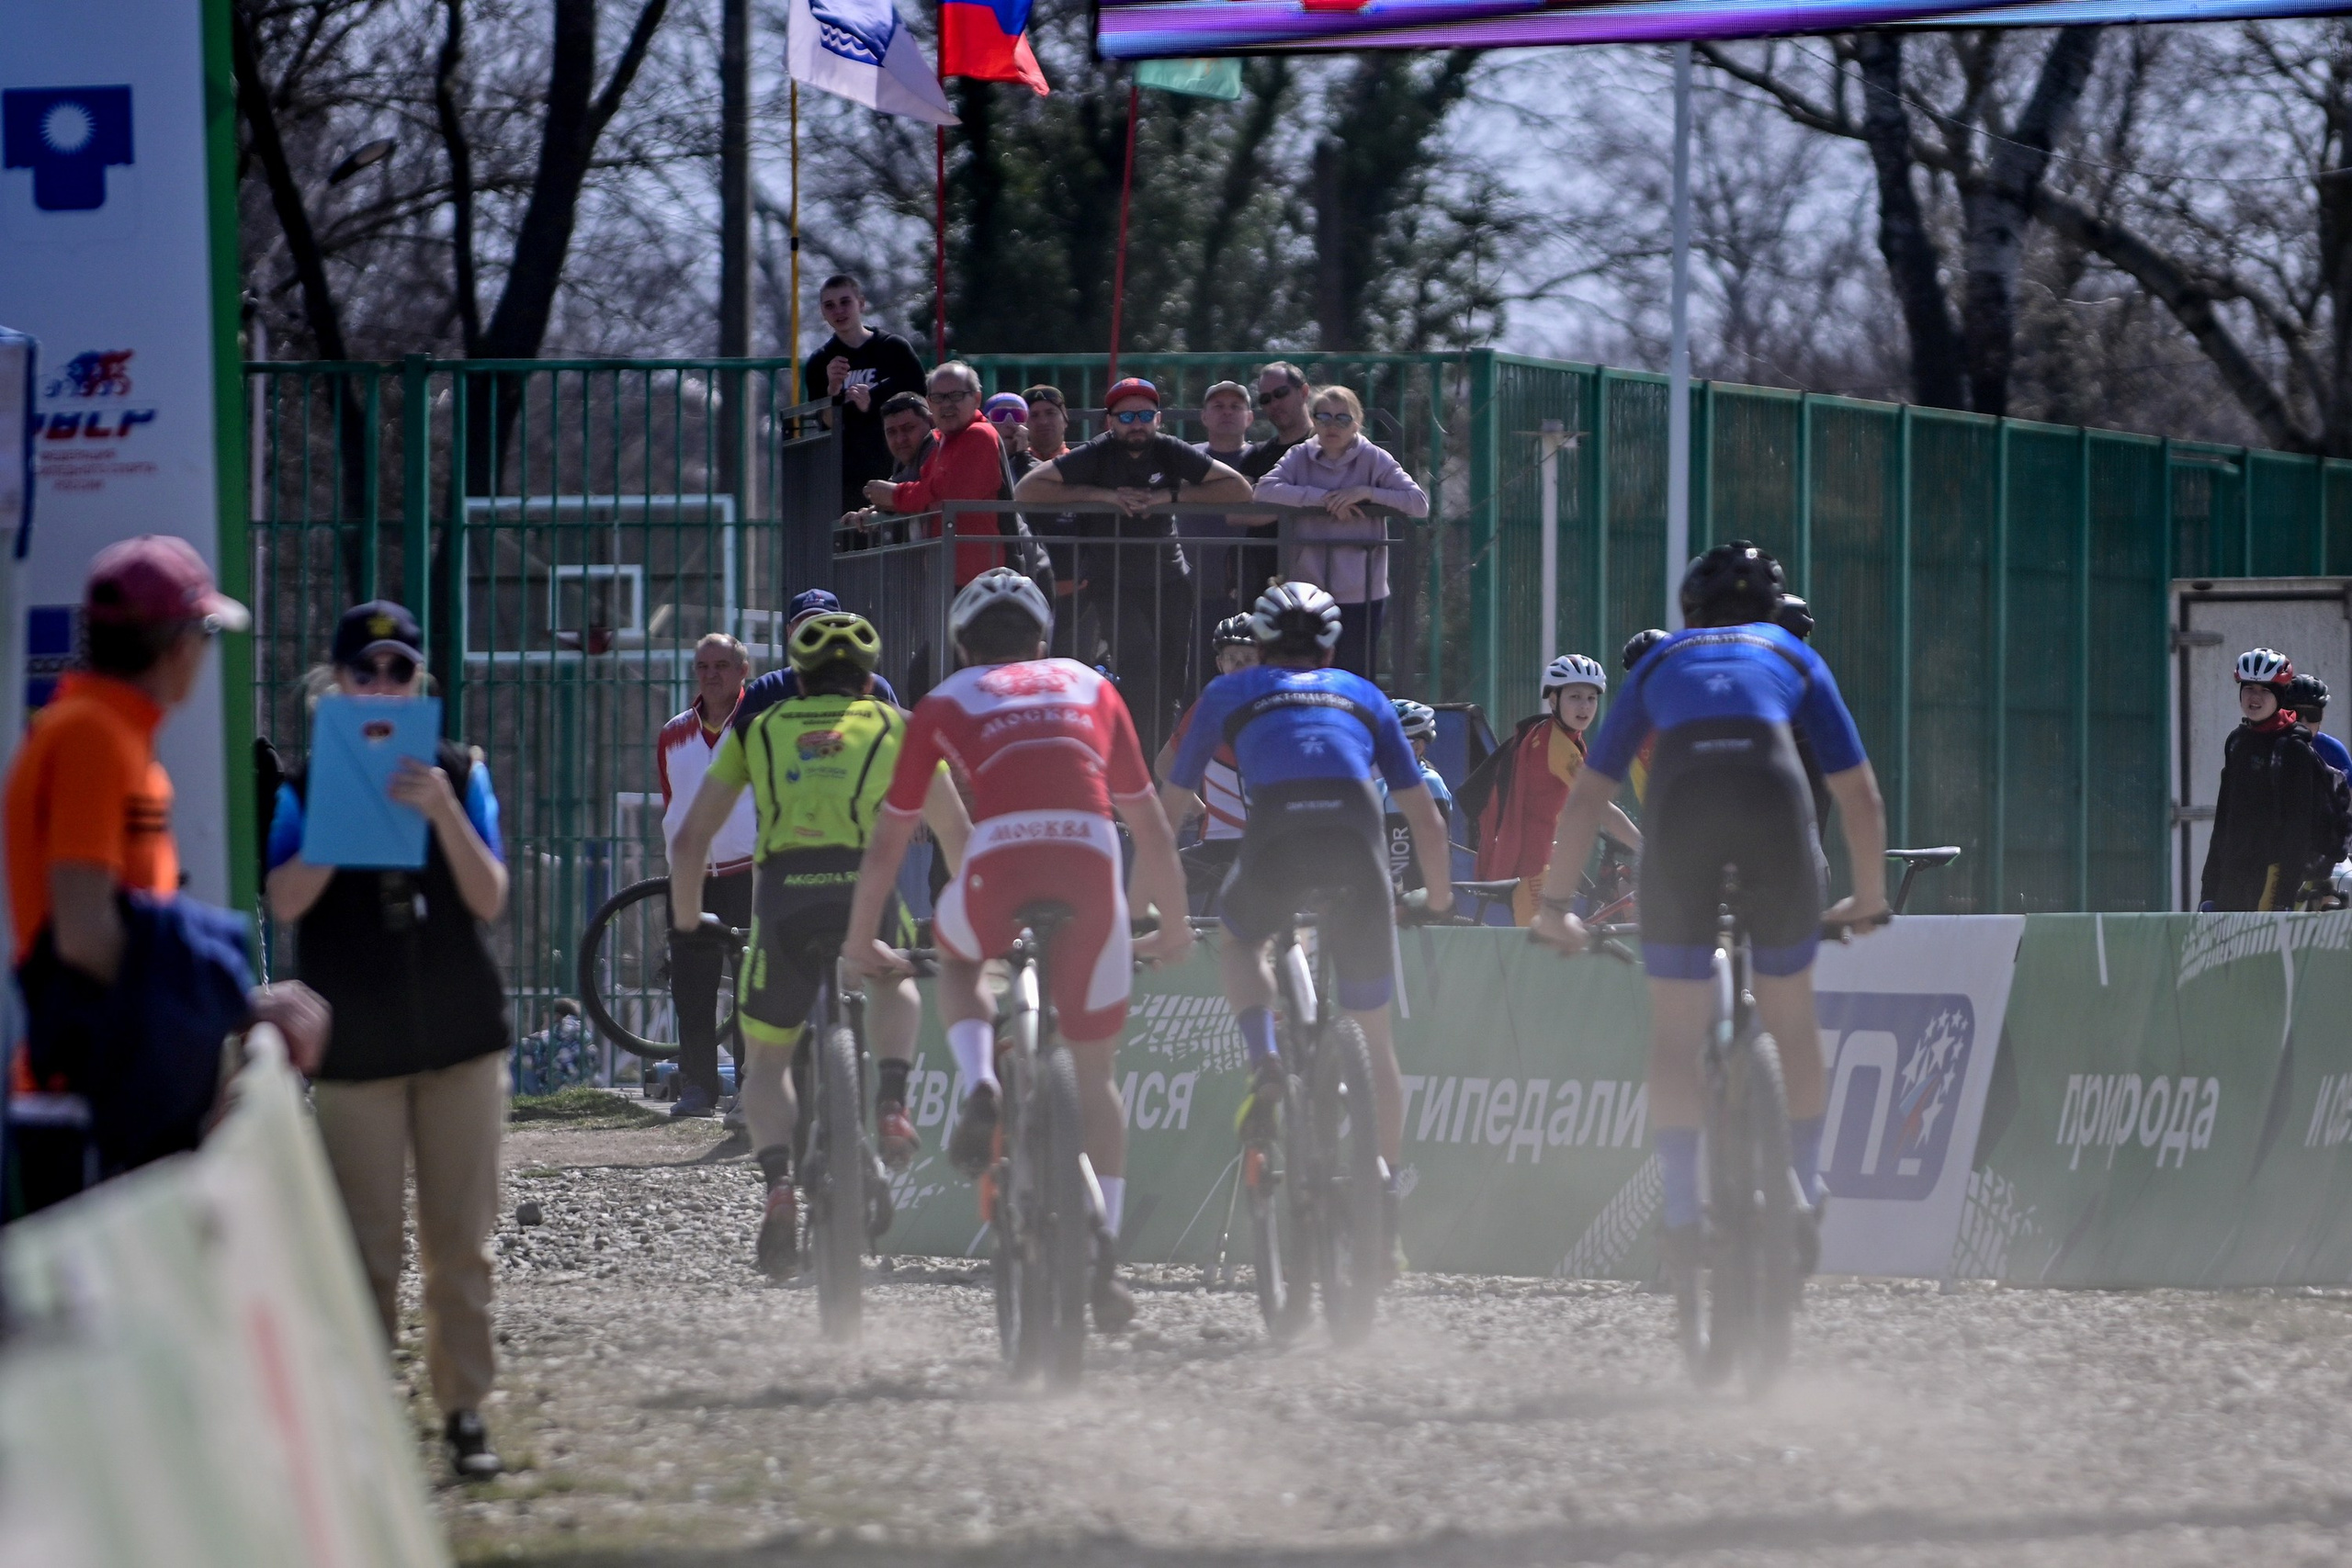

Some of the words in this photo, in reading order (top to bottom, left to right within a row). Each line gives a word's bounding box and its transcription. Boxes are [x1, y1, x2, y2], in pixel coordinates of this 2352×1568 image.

[981, 709, 1094, 740] МОСКВА
[989, 819, 1092, 842] МОСКВА
[2056, 1073, 2220, 1170] природа
